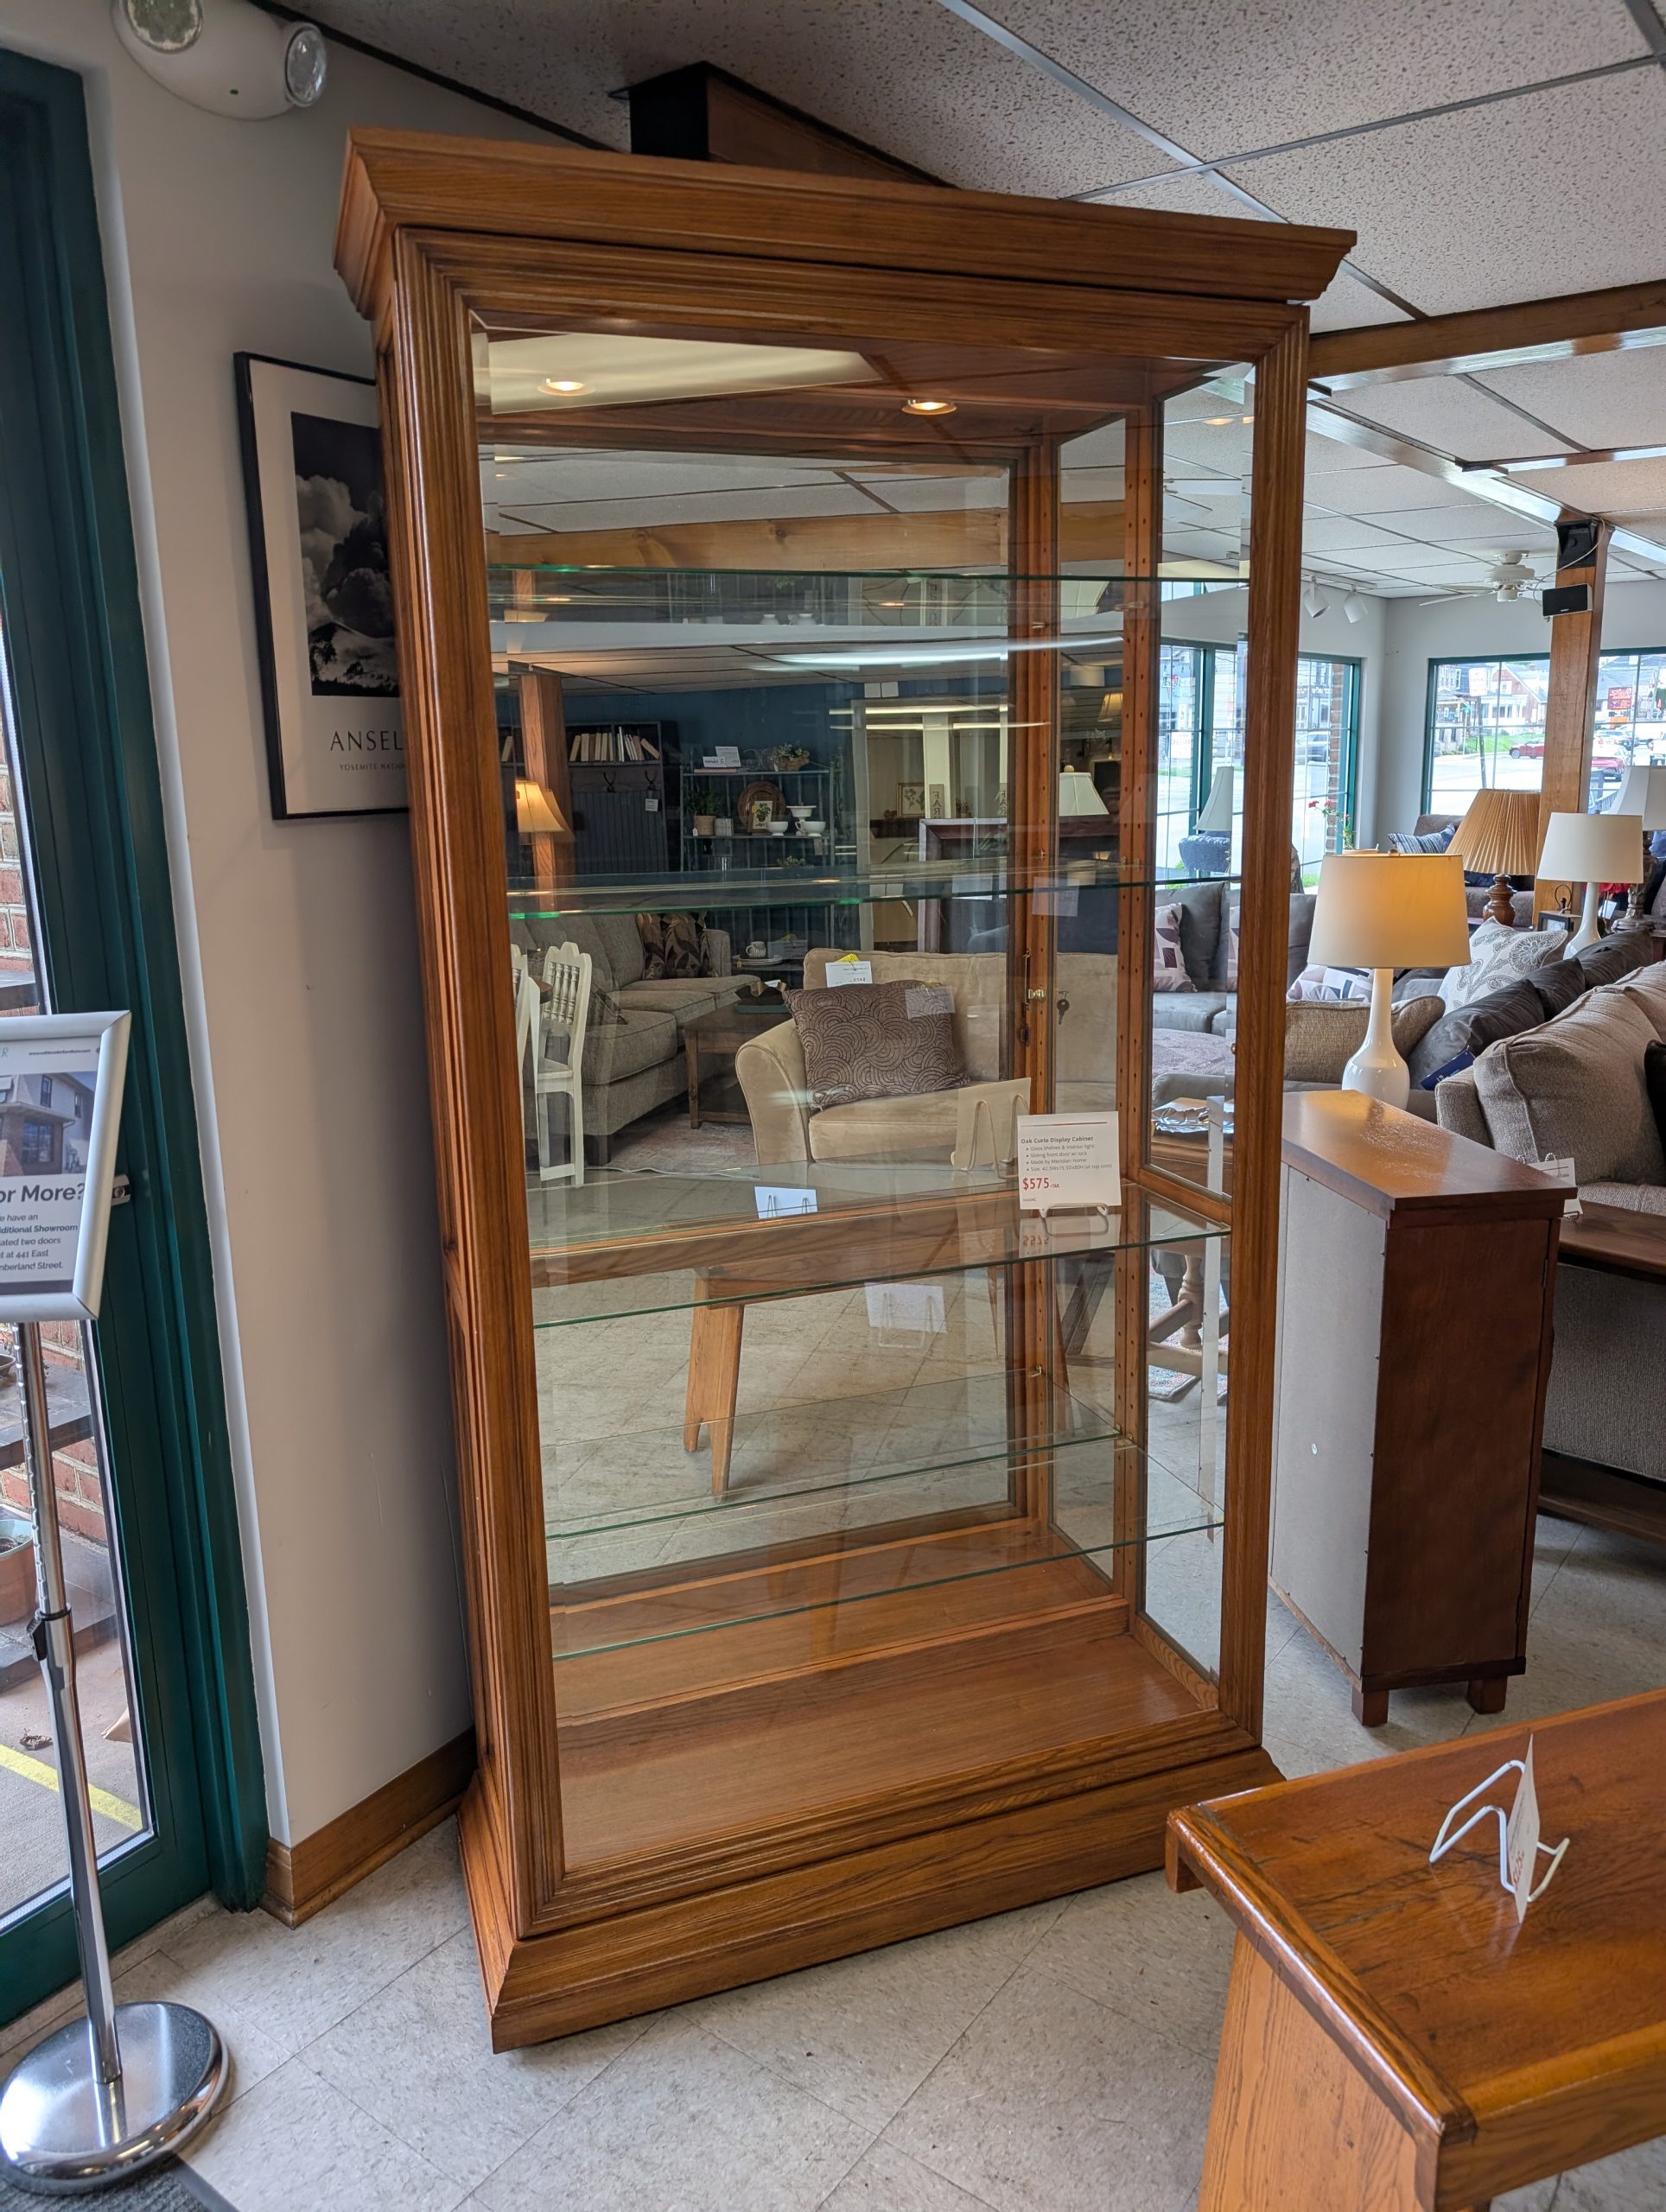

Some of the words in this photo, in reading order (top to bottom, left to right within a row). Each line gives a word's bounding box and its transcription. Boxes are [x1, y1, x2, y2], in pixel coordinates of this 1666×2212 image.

[330, 730, 404, 751] ANSEL
[1022, 1177, 1049, 1191] $575
[21, 1182, 85, 1203] More?
[34, 1224, 78, 1233] Showroom
[37, 1236, 61, 1245] doors
[16, 1250, 29, 1259] 441
[31, 1249, 48, 1257] East
